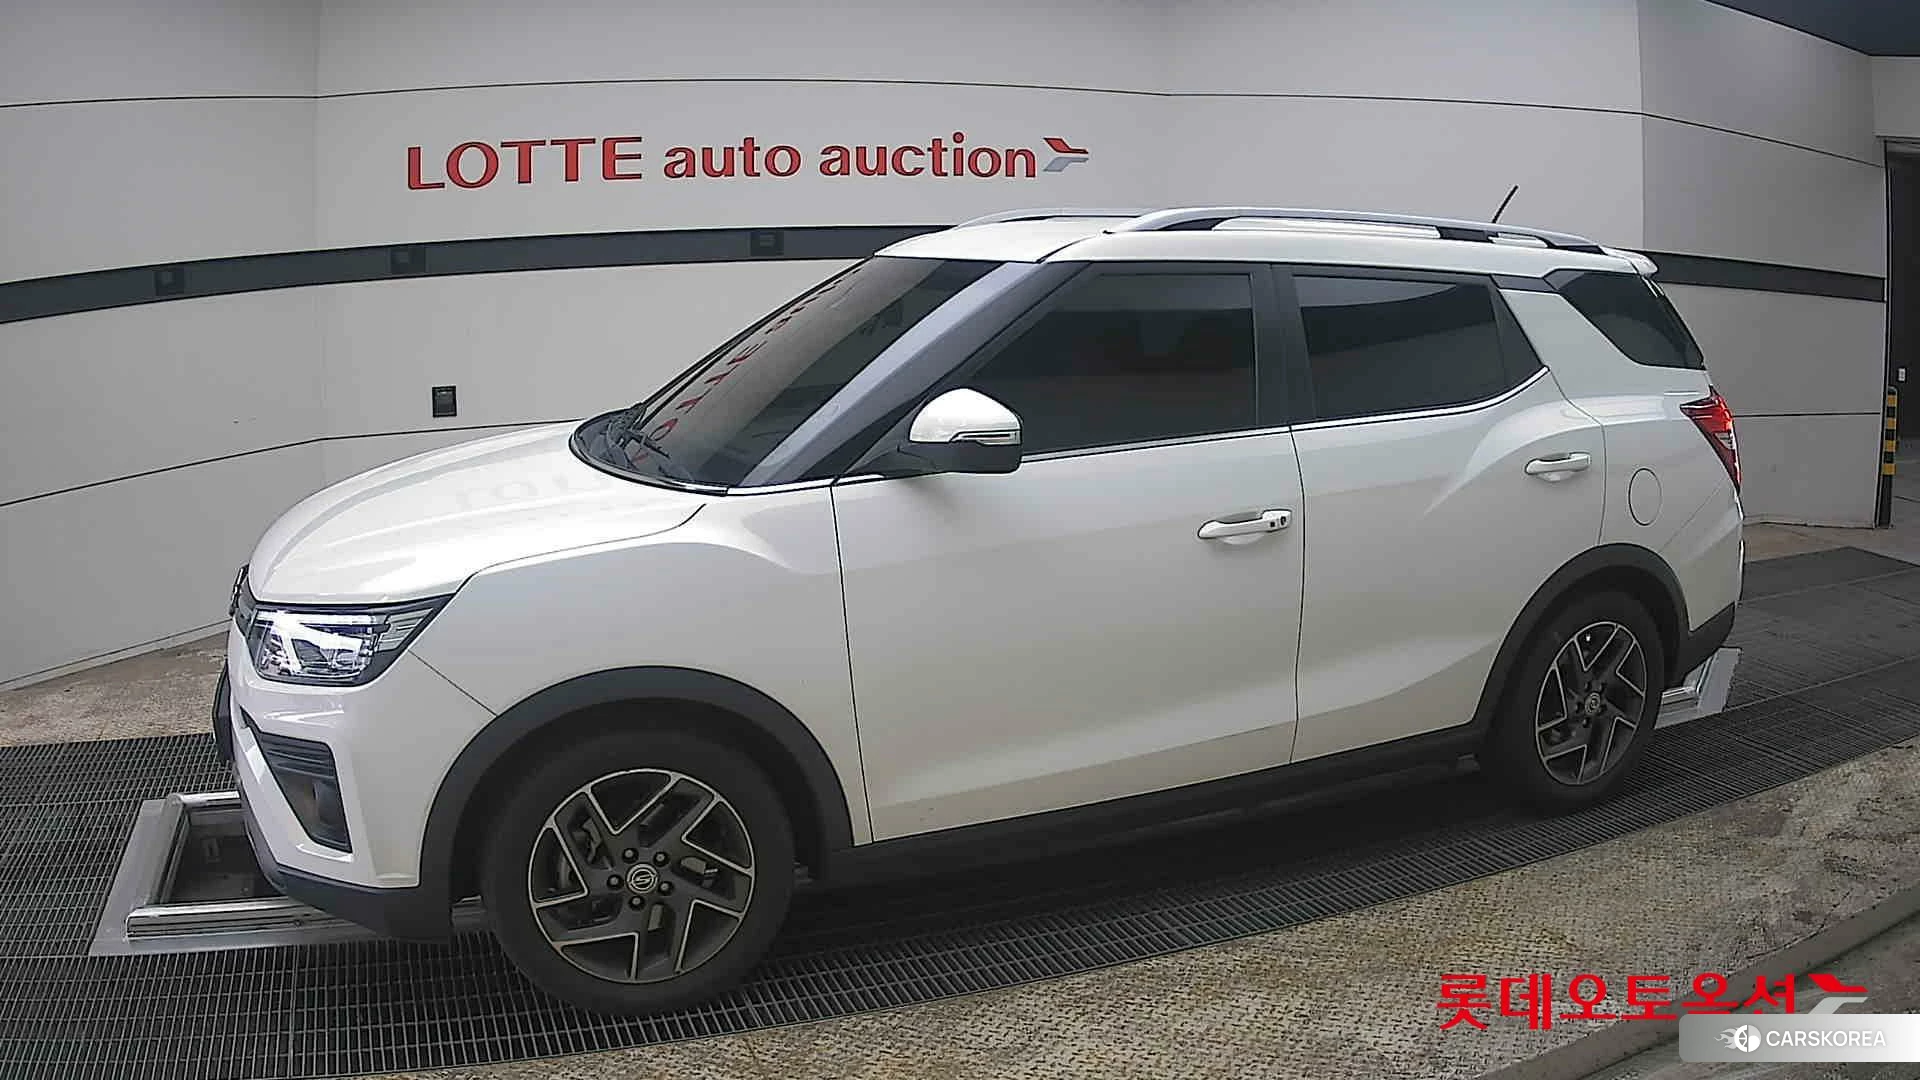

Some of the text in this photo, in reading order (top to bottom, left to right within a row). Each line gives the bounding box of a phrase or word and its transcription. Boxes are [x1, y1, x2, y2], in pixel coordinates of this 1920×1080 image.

[407, 131, 1037, 190] LOTTE auto auction
